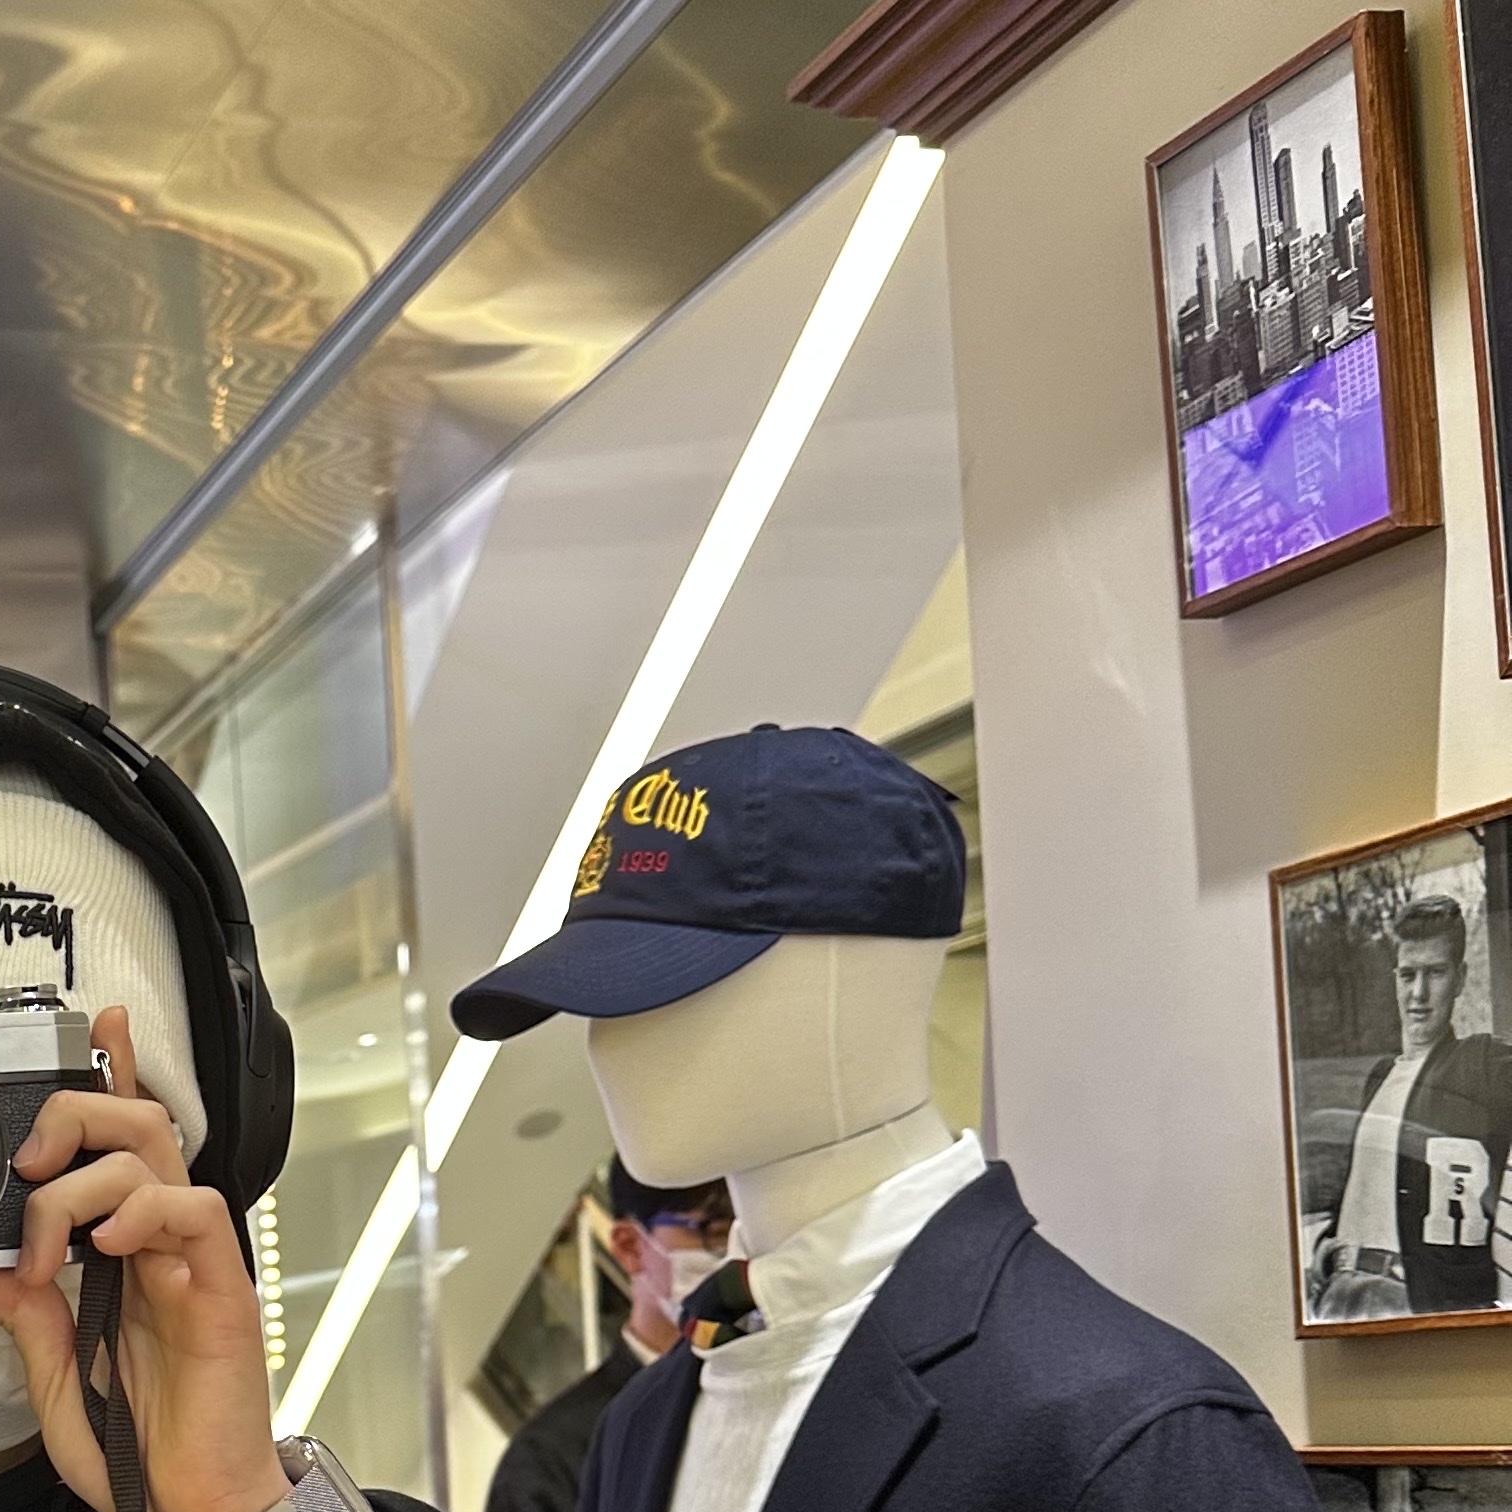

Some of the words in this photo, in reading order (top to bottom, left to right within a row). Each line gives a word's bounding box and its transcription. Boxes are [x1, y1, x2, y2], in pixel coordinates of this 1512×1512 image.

[623, 769, 710, 840] Club
[617, 851, 669, 873] 1939
[1422, 1137, 1490, 1246] R
